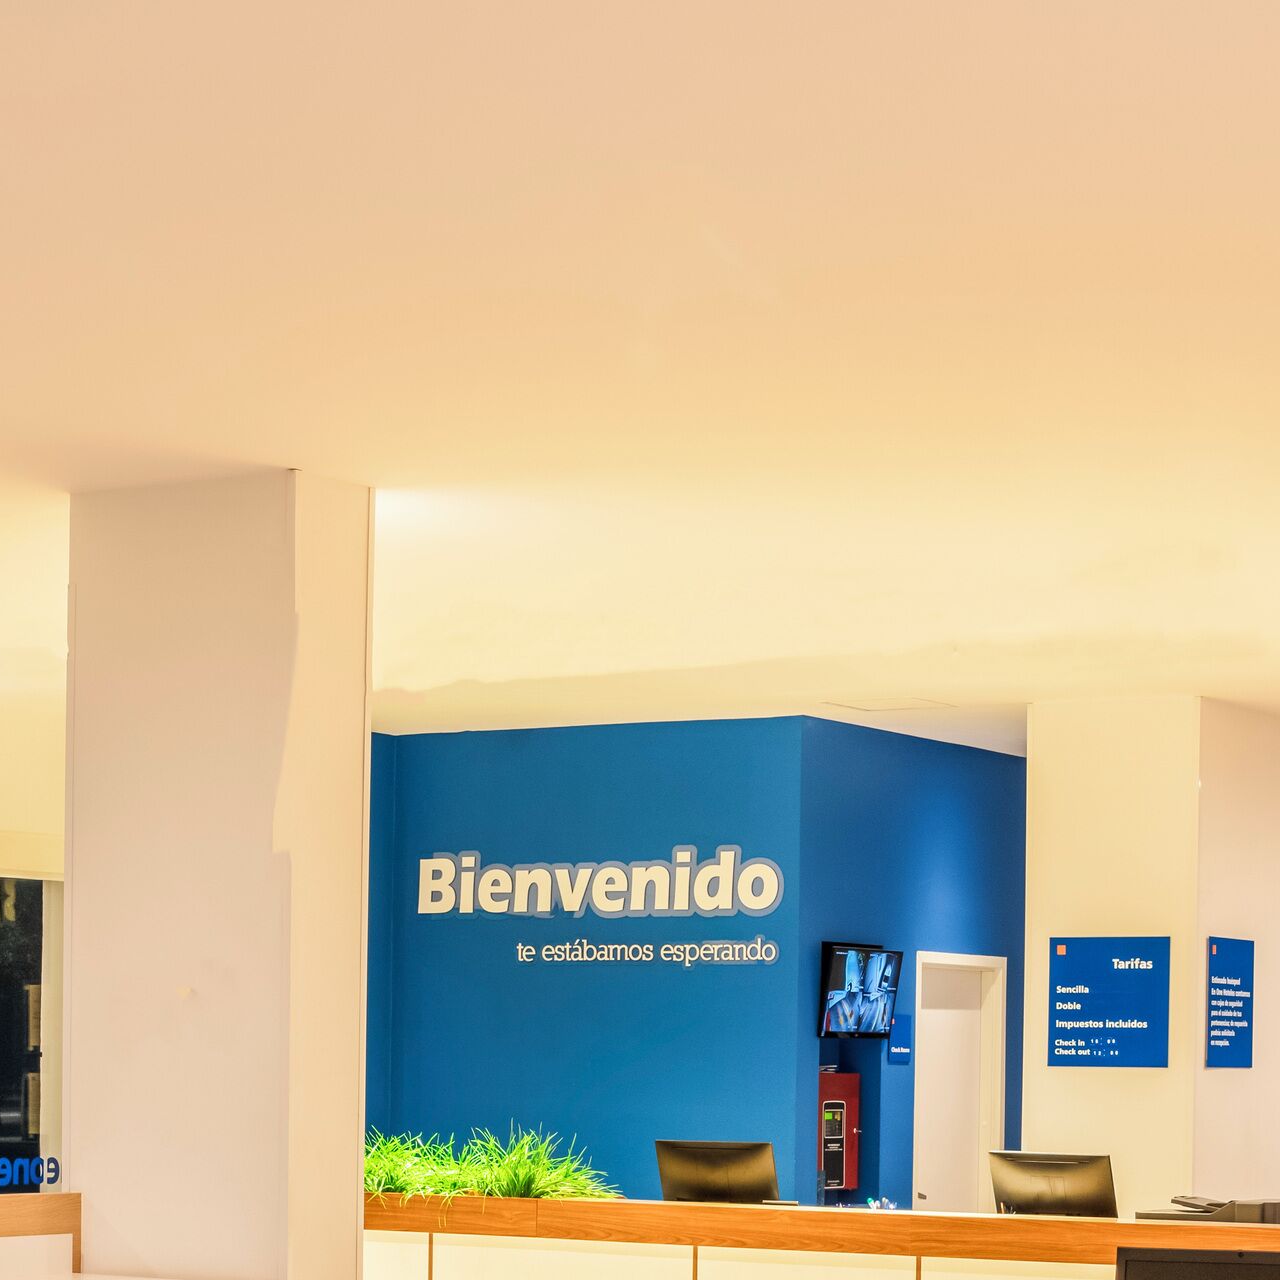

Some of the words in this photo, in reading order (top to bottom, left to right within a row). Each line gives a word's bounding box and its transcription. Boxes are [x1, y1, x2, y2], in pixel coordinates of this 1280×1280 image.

[417, 849, 779, 914] Bienvenido
[517, 941, 536, 962] te
[541, 939, 654, 963] estábamos
[660, 938, 776, 966] esperando
[1112, 958, 1153, 969] Tarifas
[1056, 985, 1089, 994] Sencilla
[1056, 1002, 1081, 1010] Doble
[1055, 1019, 1104, 1029] Impuestos
[1105, 1019, 1148, 1028] incluidos
